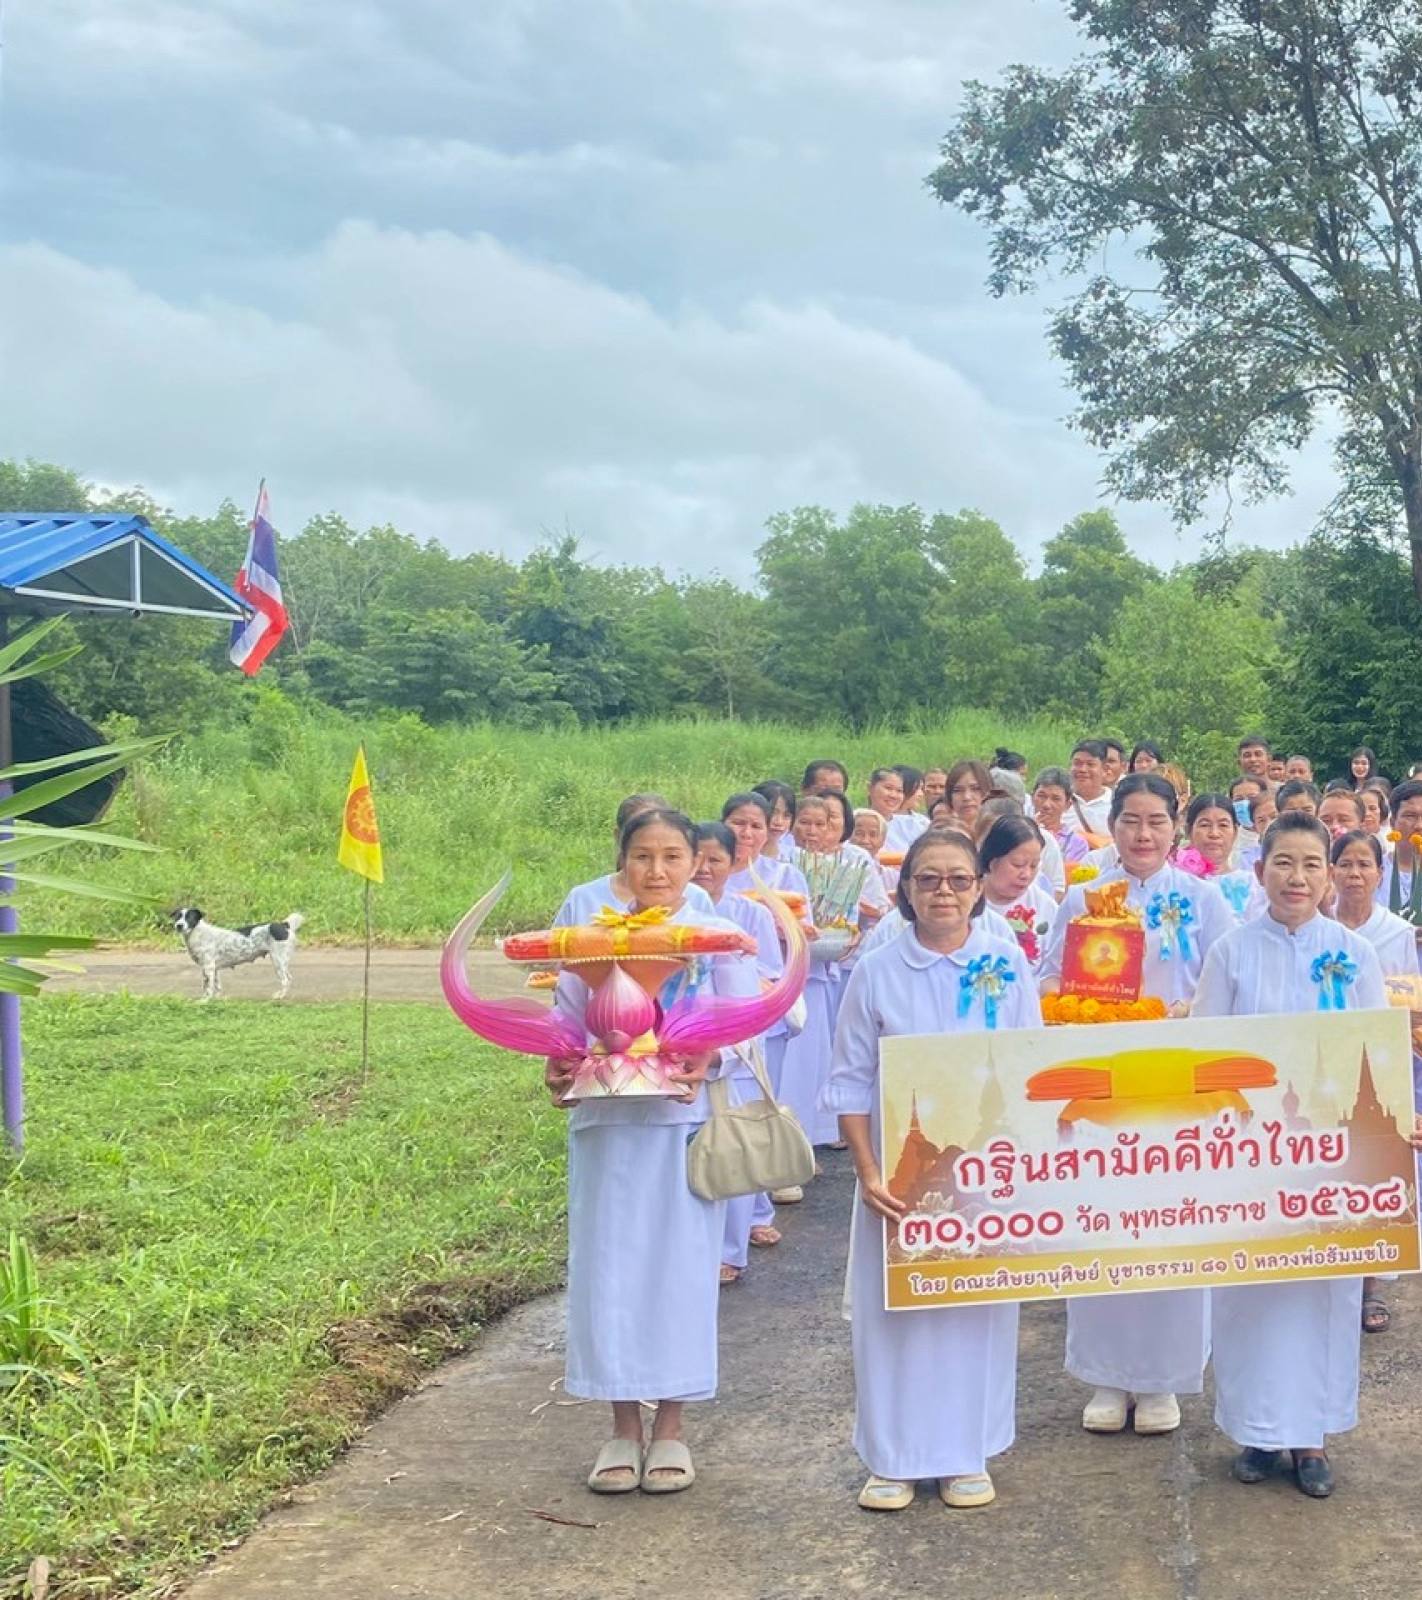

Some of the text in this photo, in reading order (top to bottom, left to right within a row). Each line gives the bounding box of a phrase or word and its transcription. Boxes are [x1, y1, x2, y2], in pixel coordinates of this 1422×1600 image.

[959, 1114, 1343, 1198] กฐินสามัคคีทั่วไทย
[904, 1182, 1402, 1247] ๓๐,๐๐๐ วัด พุทธศักราช ๒๕๖๘
[910, 1274, 947, 1294] โดย
[953, 1260, 1100, 1291] คณะศิษยานุศิษย์
[1107, 1260, 1194, 1286] บูชาธรรม
[1233, 1249, 1248, 1272] ปี
